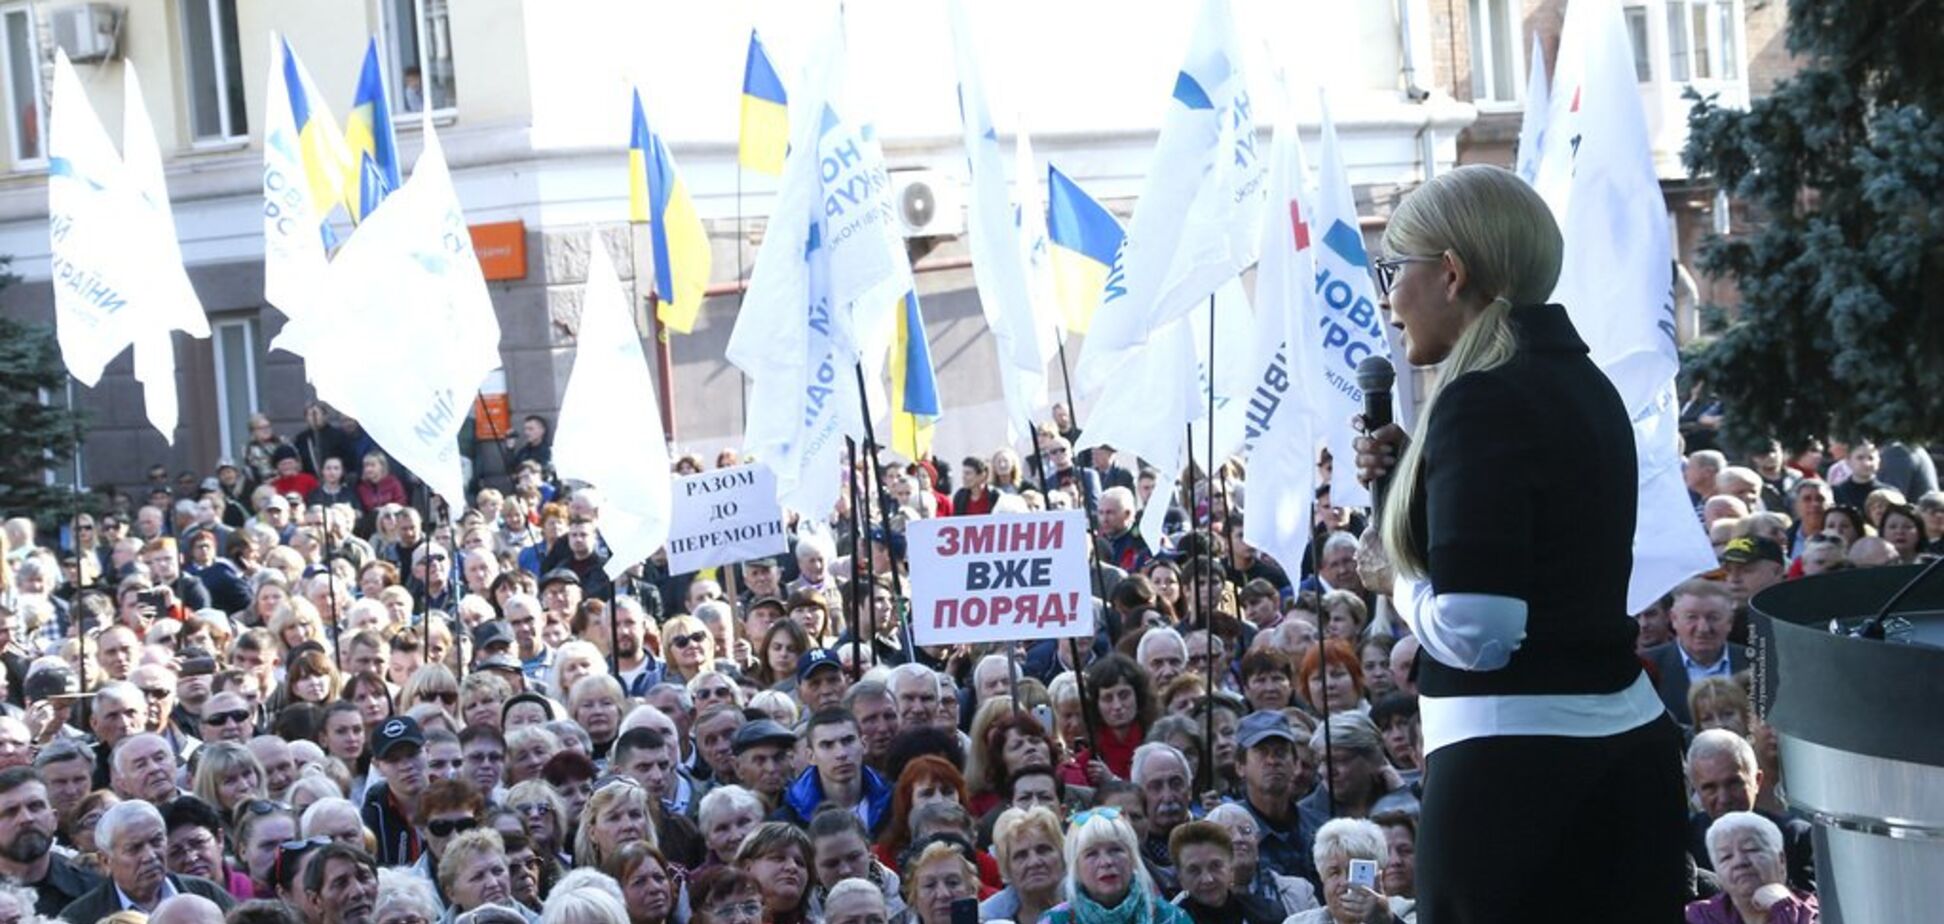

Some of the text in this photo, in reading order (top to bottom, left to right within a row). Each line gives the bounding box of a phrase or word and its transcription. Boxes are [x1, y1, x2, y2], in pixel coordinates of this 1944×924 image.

[686, 470, 755, 497] РАЗОМ
[709, 501, 738, 522] ДО
[671, 520, 783, 555] ПЕРЕМОГИ
[936, 520, 1064, 557] ЗМІНИ
[966, 557, 1053, 591] ВЖЕ
[933, 592, 1079, 629] ПОРЯД!
